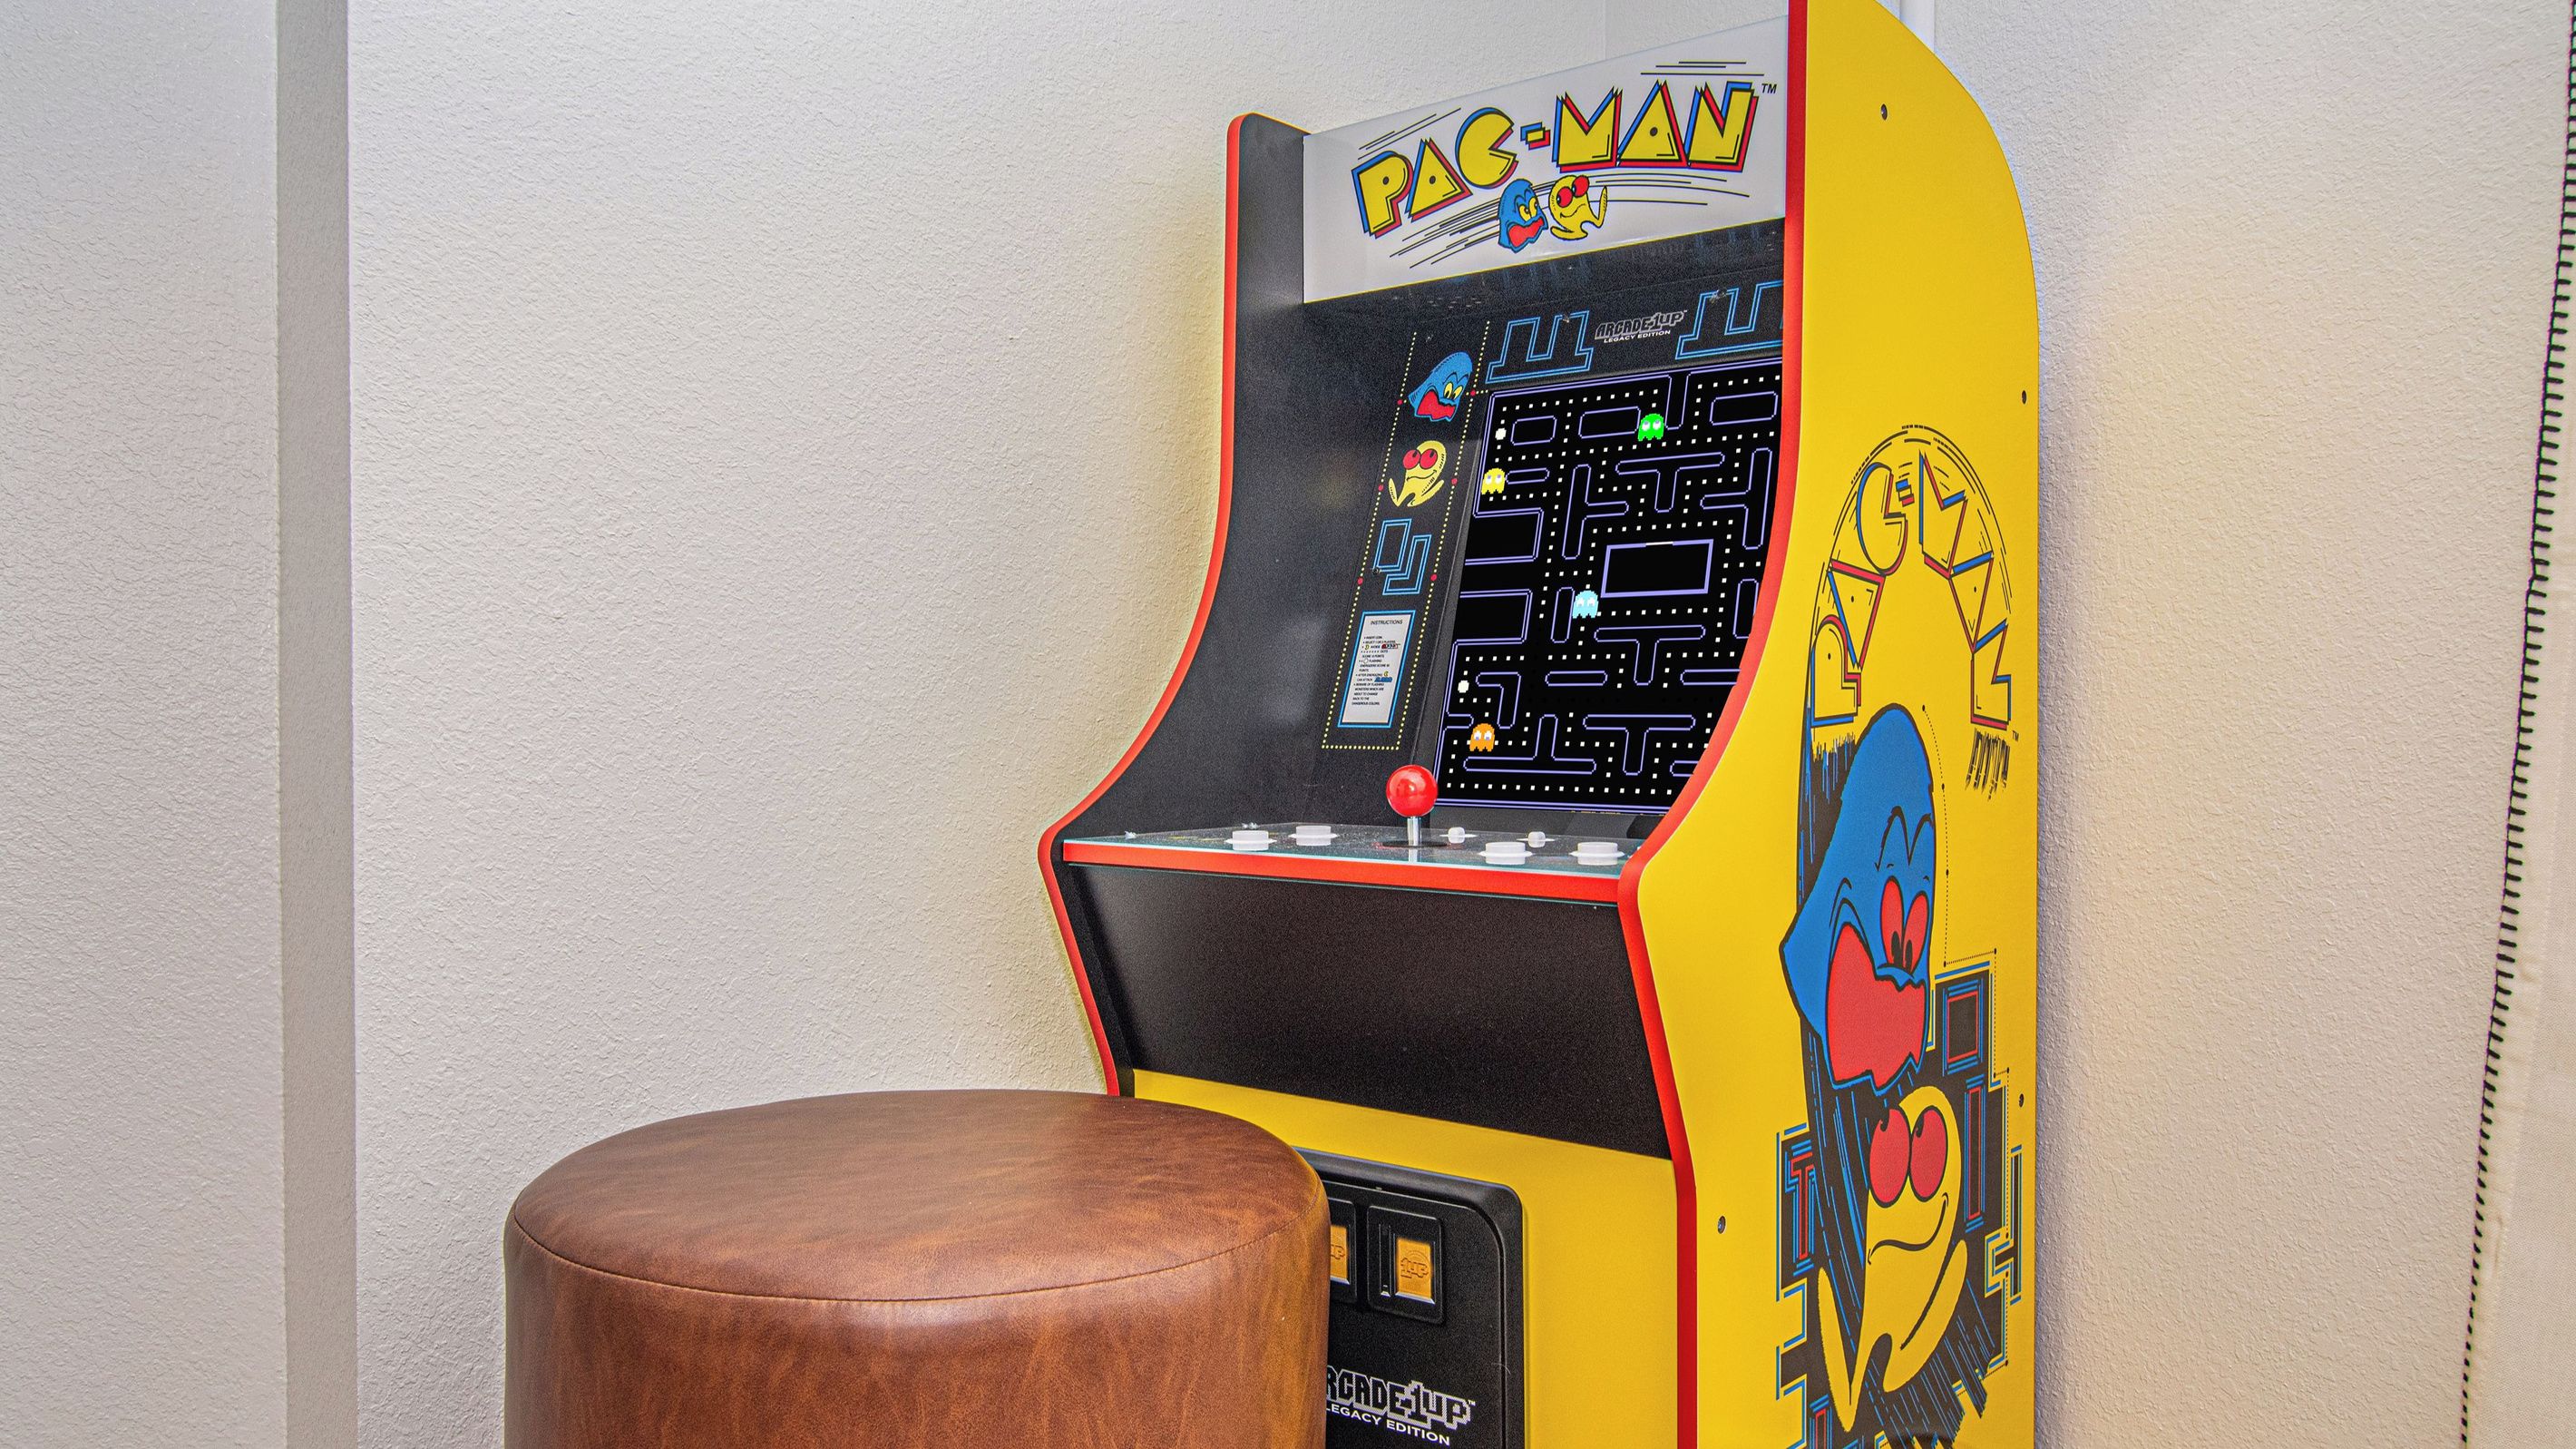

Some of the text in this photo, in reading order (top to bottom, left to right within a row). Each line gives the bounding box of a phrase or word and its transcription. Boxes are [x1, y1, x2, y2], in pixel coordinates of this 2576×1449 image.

[1351, 80, 1777, 239] PAC-MAN TM
[1604, 329, 1671, 344] LEGACY EDITION
[1326, 1365, 1471, 1430] RCADE1UP
[1386, 1419, 1450, 1446] EDITION
